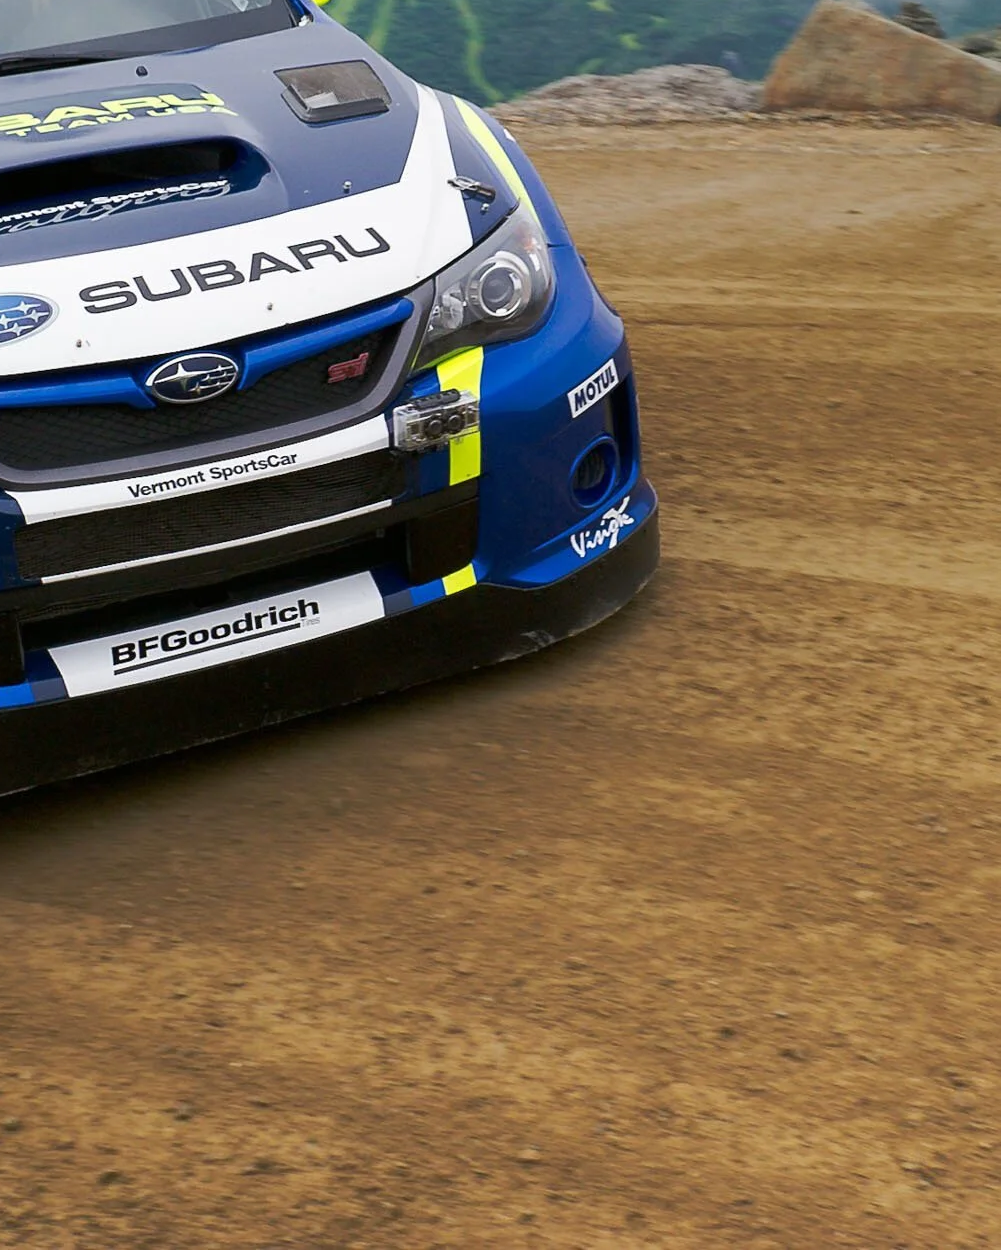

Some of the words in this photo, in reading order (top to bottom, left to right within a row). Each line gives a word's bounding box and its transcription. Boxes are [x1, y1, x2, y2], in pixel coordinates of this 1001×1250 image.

[5, 112, 135, 138] TEAM
[91, 178, 229, 206] SportsCar
[78, 226, 392, 315] SUBARU
[574, 365, 616, 412] MOTUL
[127, 470, 206, 499] Vermont
[208, 452, 298, 481] SportsCar
[110, 598, 320, 666] BFGoodrich
